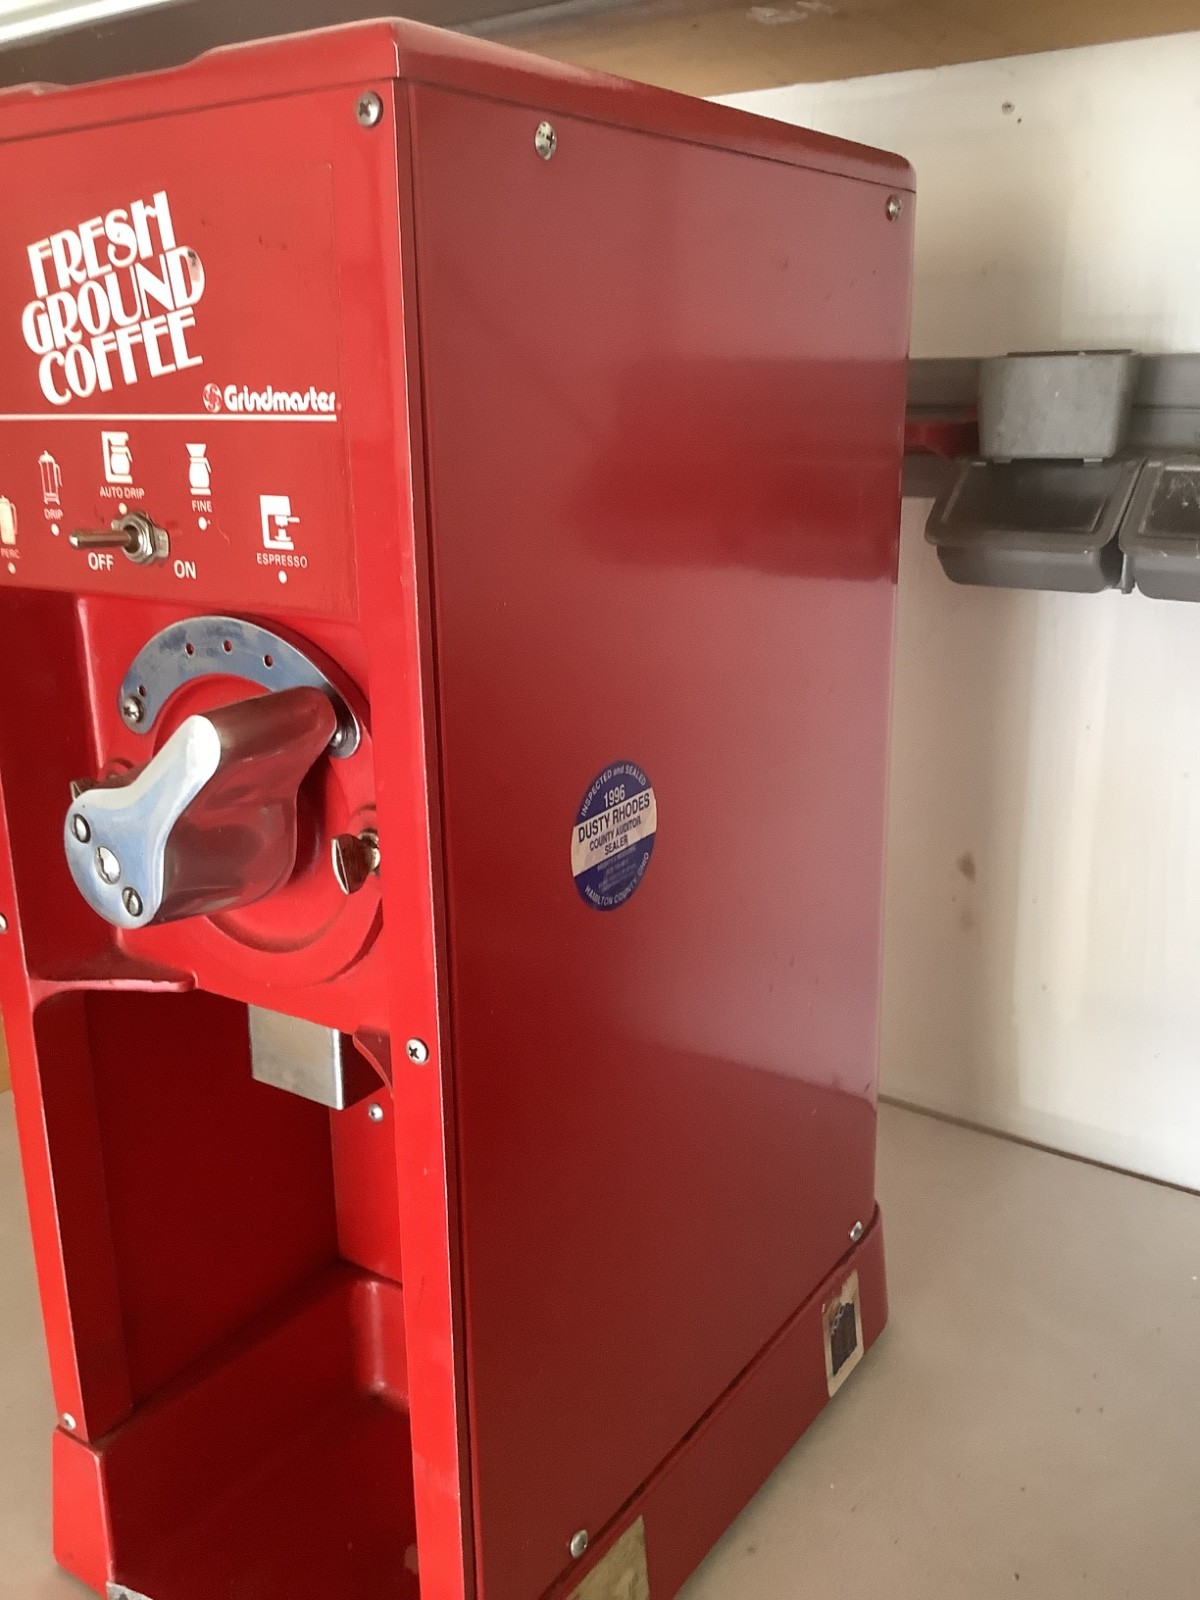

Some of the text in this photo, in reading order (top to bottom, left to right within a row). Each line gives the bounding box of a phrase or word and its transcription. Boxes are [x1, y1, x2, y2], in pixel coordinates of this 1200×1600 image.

[27, 190, 176, 299] FRESH
[22, 246, 206, 355] GROUND
[38, 307, 203, 405] COFFEE
[224, 385, 336, 412] Grindmaster
[100, 486, 145, 500] AUTO DRIP
[44, 508, 63, 520] DRIP
[192, 500, 212, 513] FINE
[88, 552, 114, 571] OFF
[174, 560, 197, 580] ON
[256, 552, 308, 569] ESPRESSO
[581, 769, 612, 817] INSPECTED
[625, 764, 647, 786] SEALED
[604, 784, 625, 808] 1996
[578, 792, 650, 843] DUSTY RHODES
[589, 816, 642, 852] COUNTY AUDITOR
[604, 834, 629, 855] SEALER
